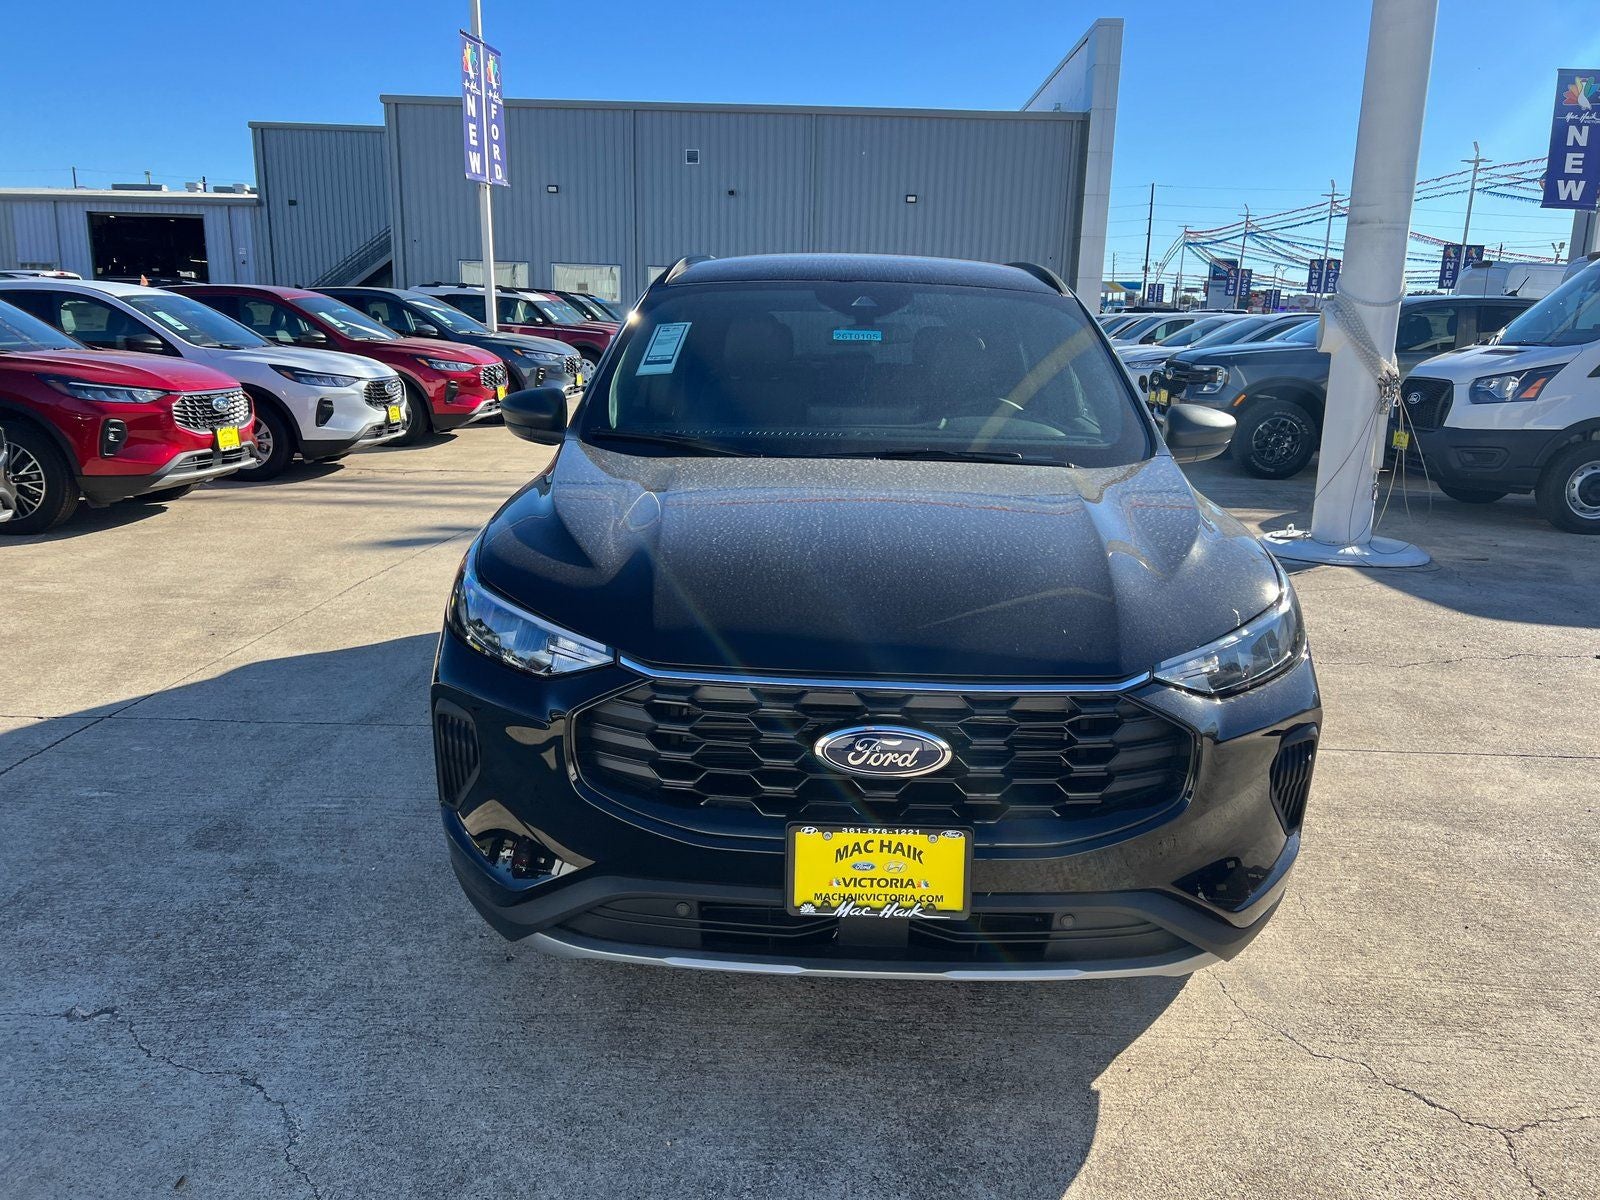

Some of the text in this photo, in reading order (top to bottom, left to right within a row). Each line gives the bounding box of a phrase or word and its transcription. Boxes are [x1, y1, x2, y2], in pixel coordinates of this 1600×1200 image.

[466, 93, 481, 174] NEW
[491, 104, 503, 180] FORD
[1557, 125, 1590, 201] NEW
[1310, 272, 1319, 292] NEW
[1327, 272, 1335, 292] FORD
[1442, 262, 1454, 287] NEW
[1227, 279, 1235, 295] NEW
[847, 738, 920, 767] Ford
[841, 827, 920, 836] 361-576-1221
[835, 839, 924, 865] MAC HAIK
[841, 877, 916, 889] VICTORIA
[814, 892, 944, 903] MACHAIKVICTORIA.COM
[834, 900, 927, 919] Mac Haik
